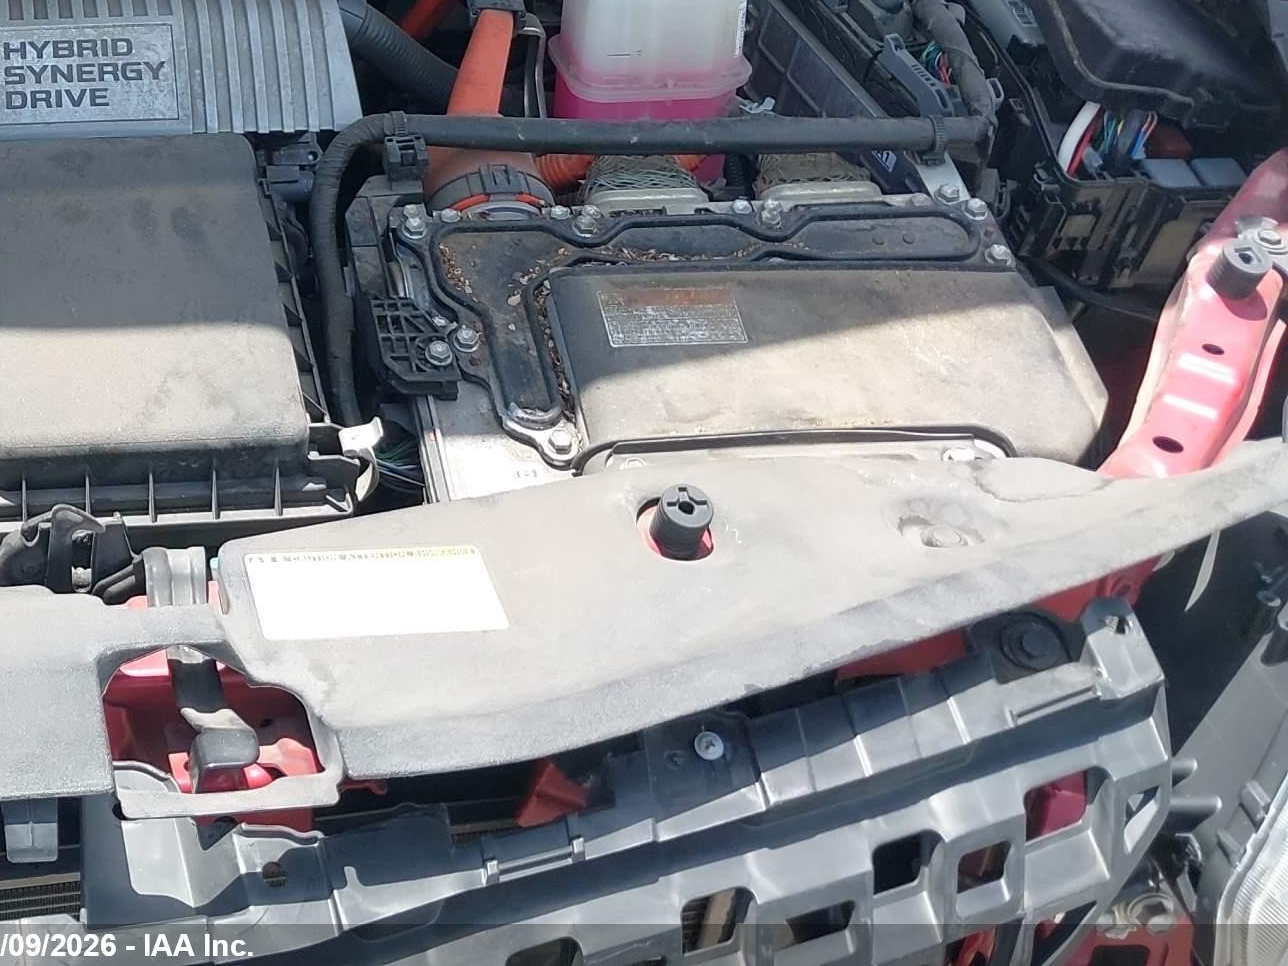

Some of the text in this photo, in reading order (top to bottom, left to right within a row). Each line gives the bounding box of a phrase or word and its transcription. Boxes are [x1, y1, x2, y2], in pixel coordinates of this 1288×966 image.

[3, 38, 133, 60] HYBRID
[4, 61, 166, 84] SYNERGY
[5, 88, 110, 110] DRIVE
